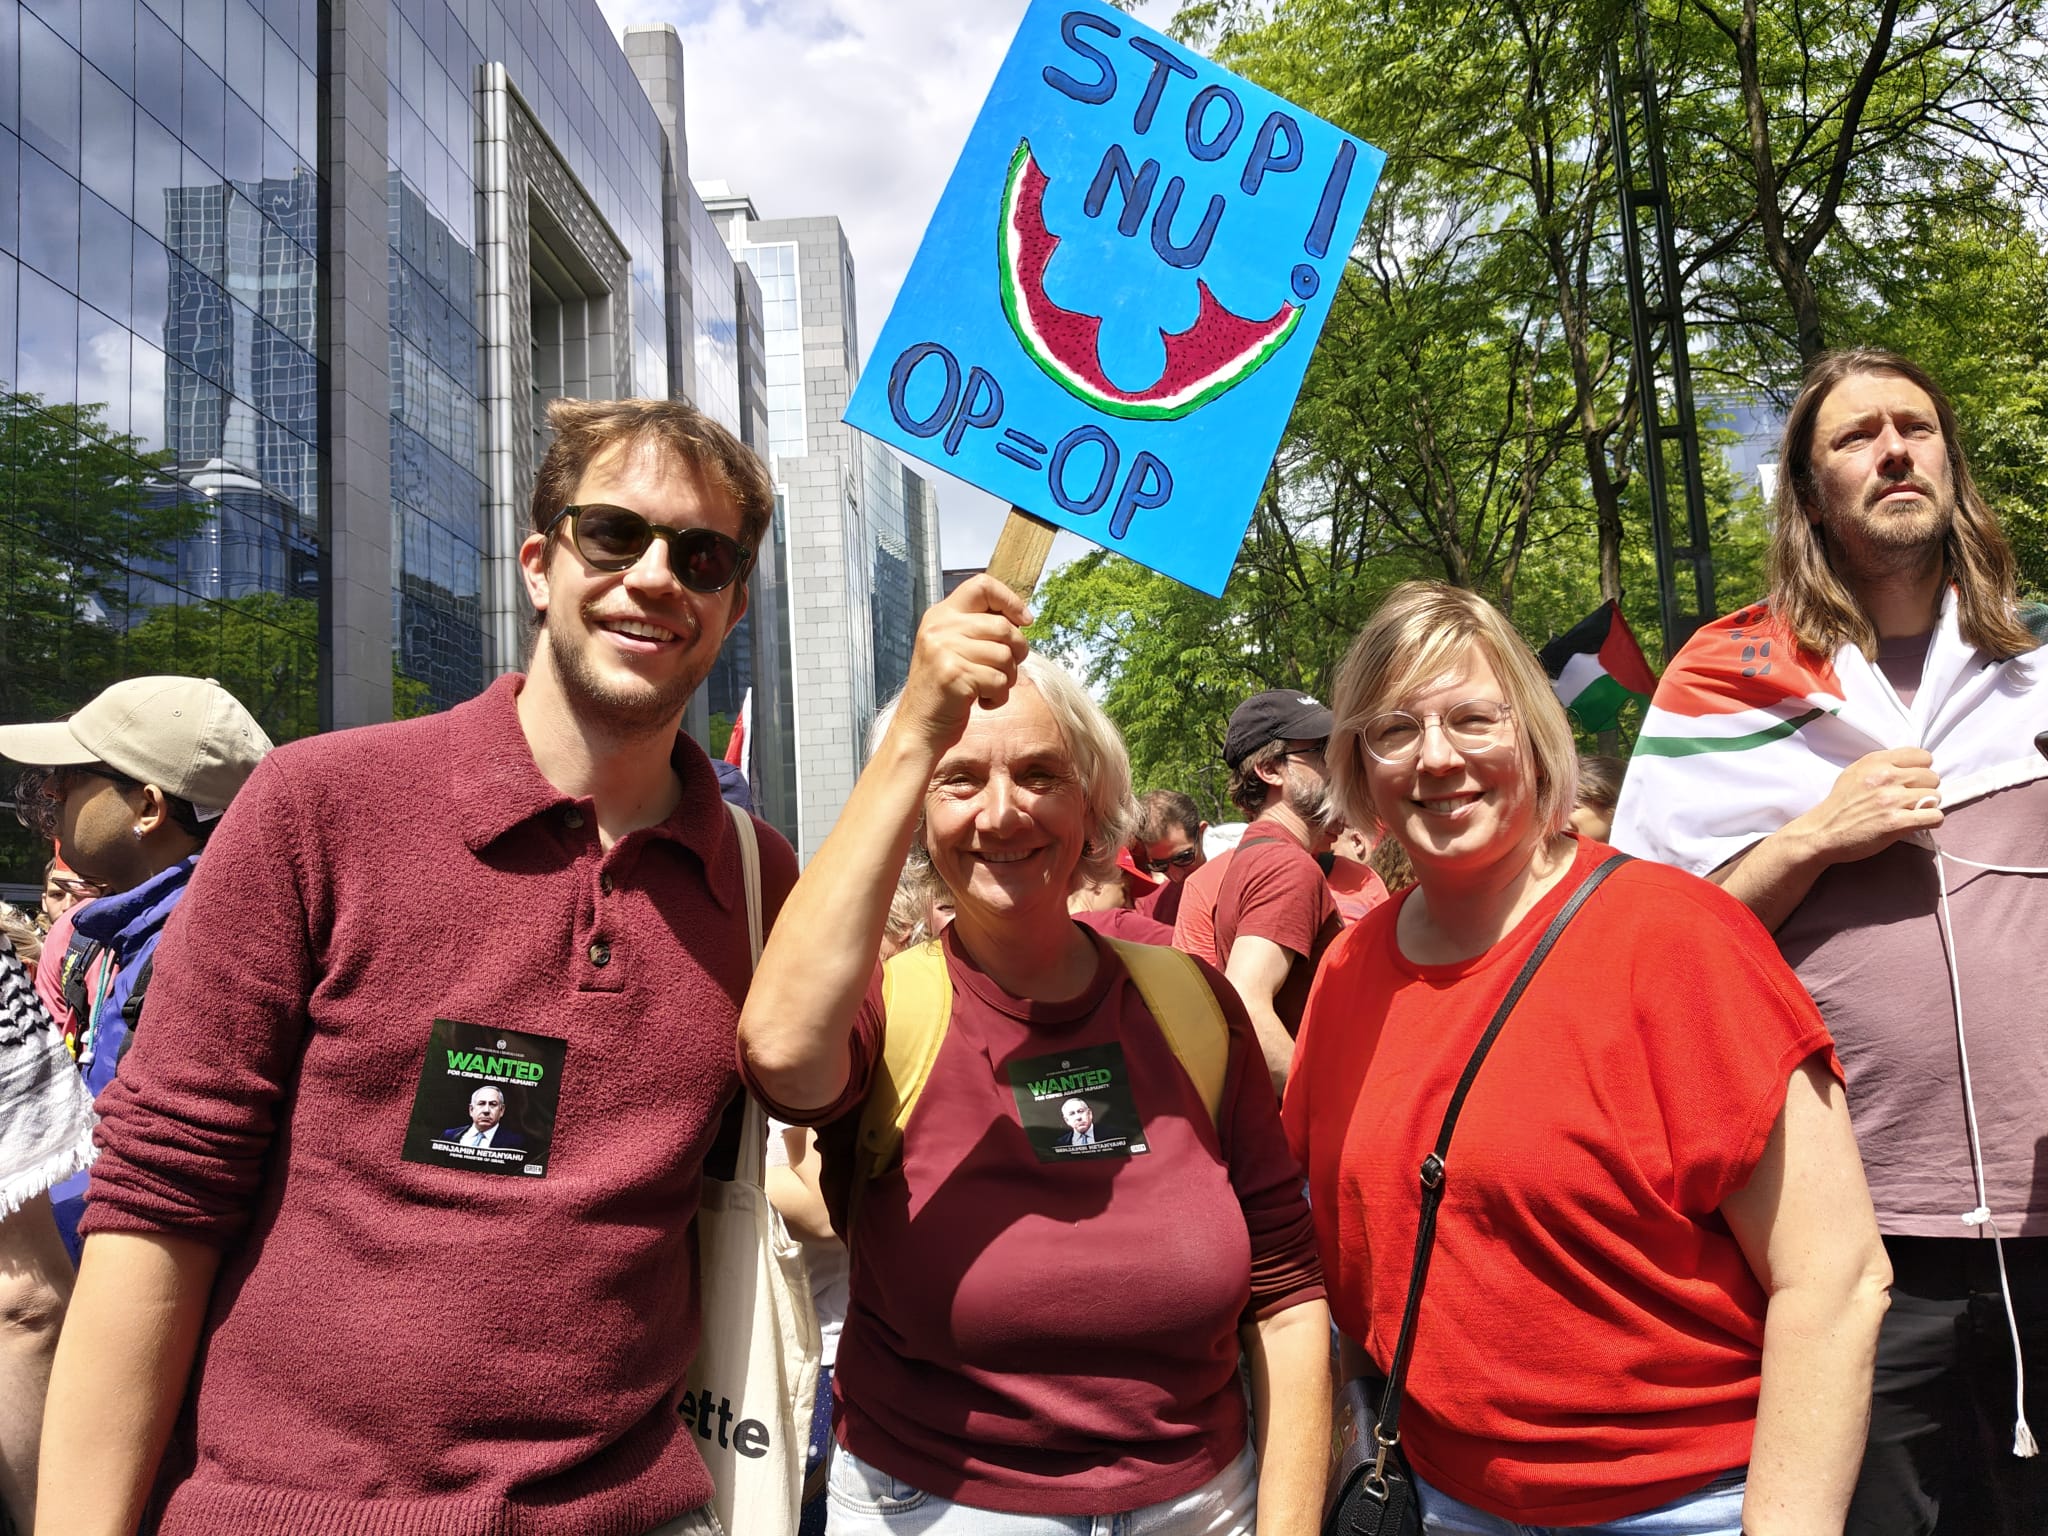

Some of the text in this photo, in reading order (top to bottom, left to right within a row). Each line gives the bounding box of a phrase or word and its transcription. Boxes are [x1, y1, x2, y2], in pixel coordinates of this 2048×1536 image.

[1042, 10, 1303, 196] STOP
[1083, 143, 1226, 270] NU
[446, 1049, 544, 1081] WANTED
[484, 1074, 509, 1084] AGAINST
[509, 1078, 539, 1088] HUMANITY
[1027, 1068, 1113, 1097] WANTED
[431, 1142, 524, 1162] BENJAMIN NETANYAHU
[676, 1389, 770, 1459] ette
